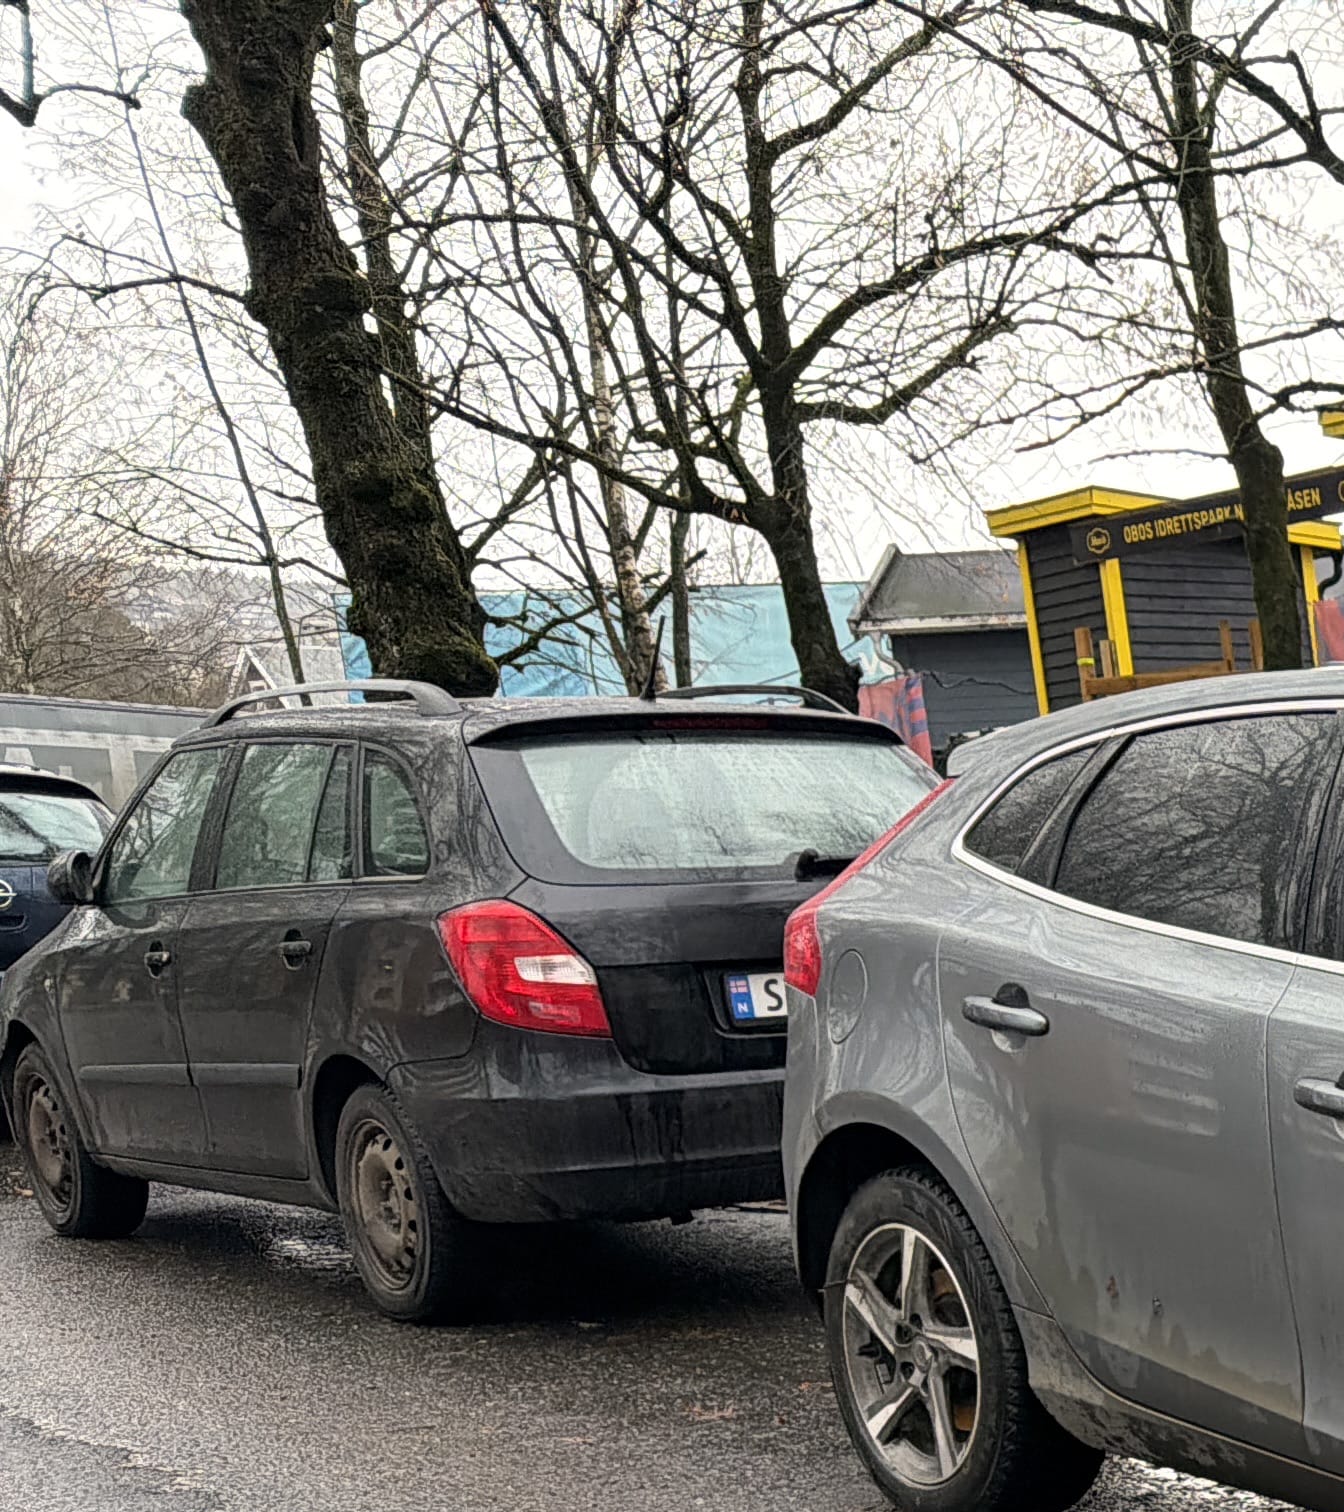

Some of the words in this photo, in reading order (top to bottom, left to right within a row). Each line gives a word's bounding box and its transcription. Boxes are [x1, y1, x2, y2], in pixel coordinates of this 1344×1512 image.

[1123, 521, 1154, 544] OBOS
[1153, 506, 1231, 538] IDRETTSPARK
[1286, 486, 1322, 512] ÅSEN
[737, 1002, 749, 1014] N
